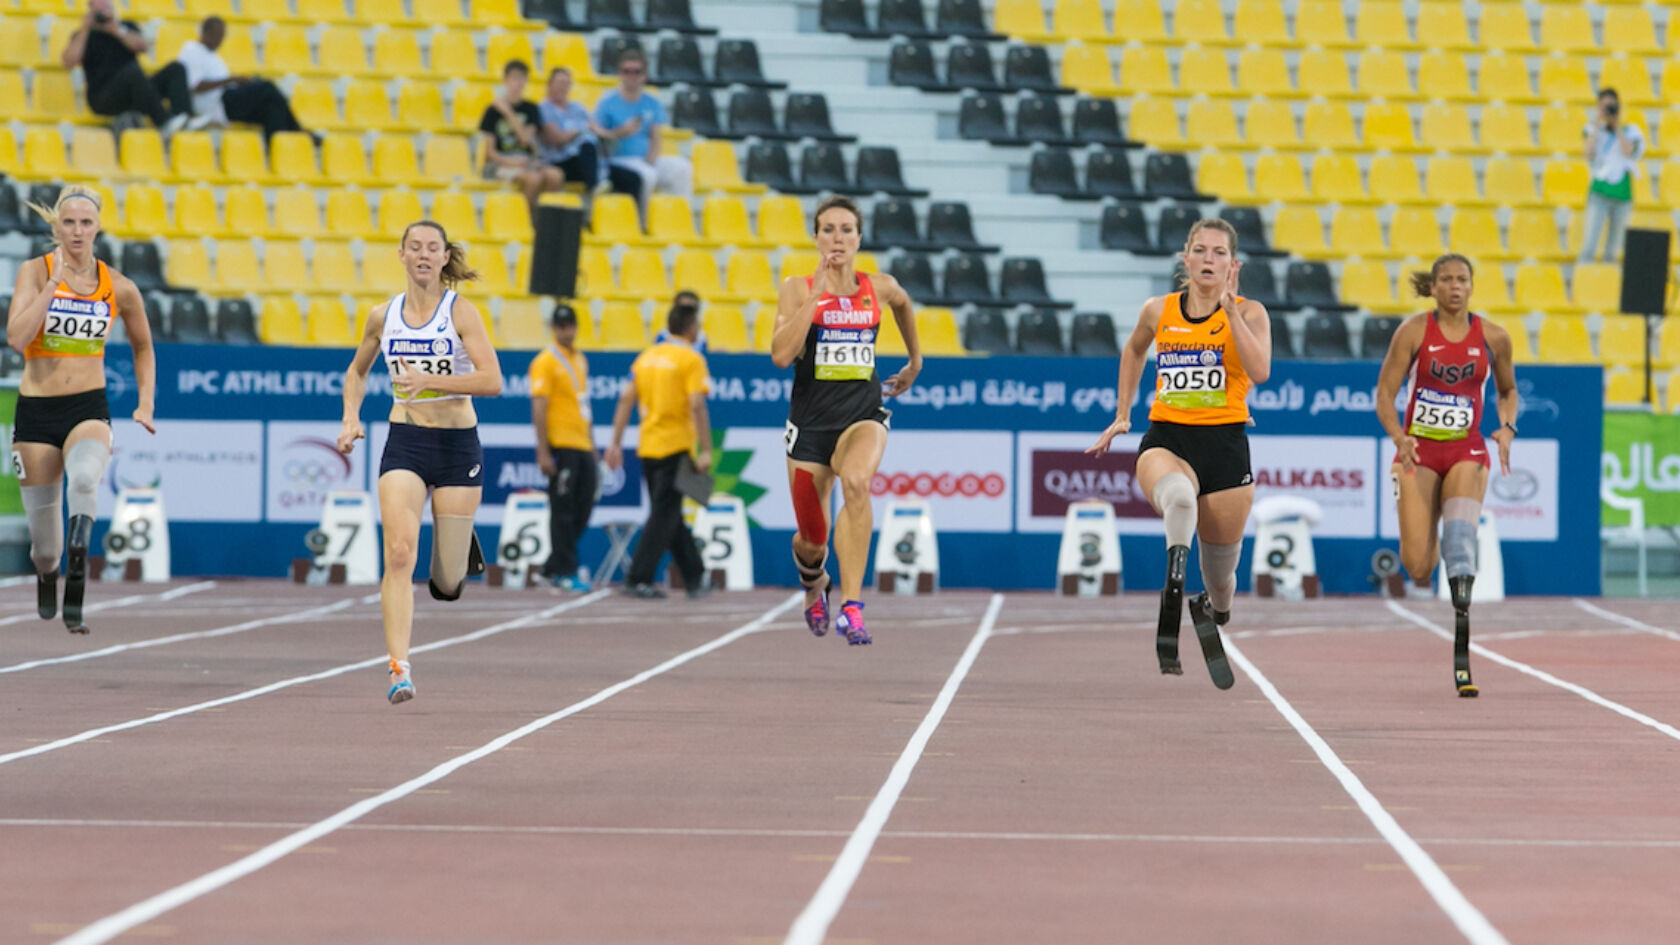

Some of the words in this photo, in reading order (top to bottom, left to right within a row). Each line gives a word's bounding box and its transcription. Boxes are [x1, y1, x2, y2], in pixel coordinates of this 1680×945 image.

[51, 298, 92, 313] Allianz
[47, 315, 109, 338] 2042
[823, 310, 873, 325] GERMANY
[392, 340, 430, 353] Allianz
[821, 330, 860, 341] Allianz
[821, 346, 872, 364] 1610
[1160, 353, 1199, 367] Allianz
[178, 370, 219, 394] IPC
[1431, 359, 1475, 385] USA
[1415, 404, 1470, 428] 2563
[1044, 469, 1130, 500] QATAR
[1256, 469, 1364, 489] ALKASS
[129, 519, 151, 552] 8
[337, 523, 359, 557] 7
[518, 522, 541, 557] 6
[709, 526, 733, 560] 5
